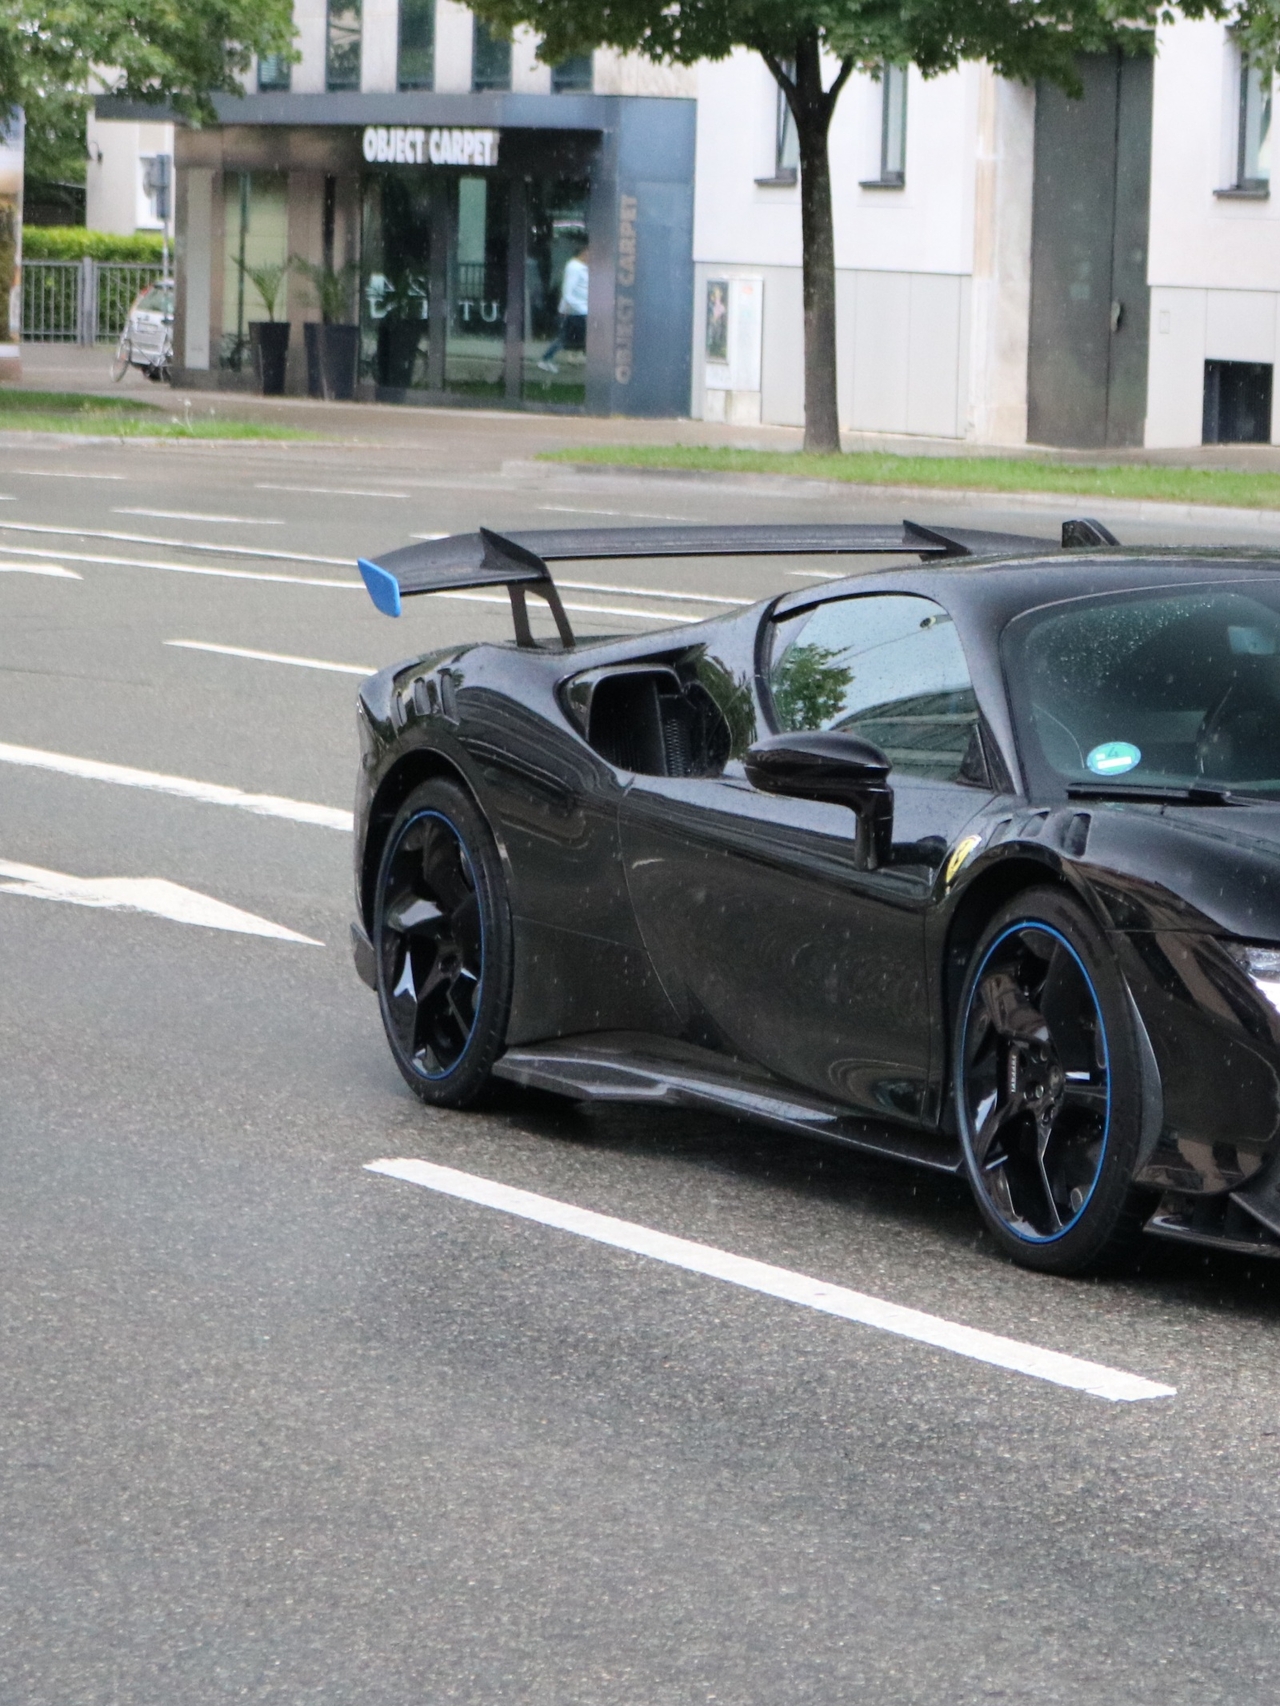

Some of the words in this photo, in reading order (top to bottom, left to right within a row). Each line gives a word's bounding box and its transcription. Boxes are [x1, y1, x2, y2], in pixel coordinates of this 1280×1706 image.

[363, 126, 425, 164] OBJECT
[429, 128, 497, 166] CARPET
[619, 194, 637, 286] CARPET
[615, 296, 634, 384] OBJECT
